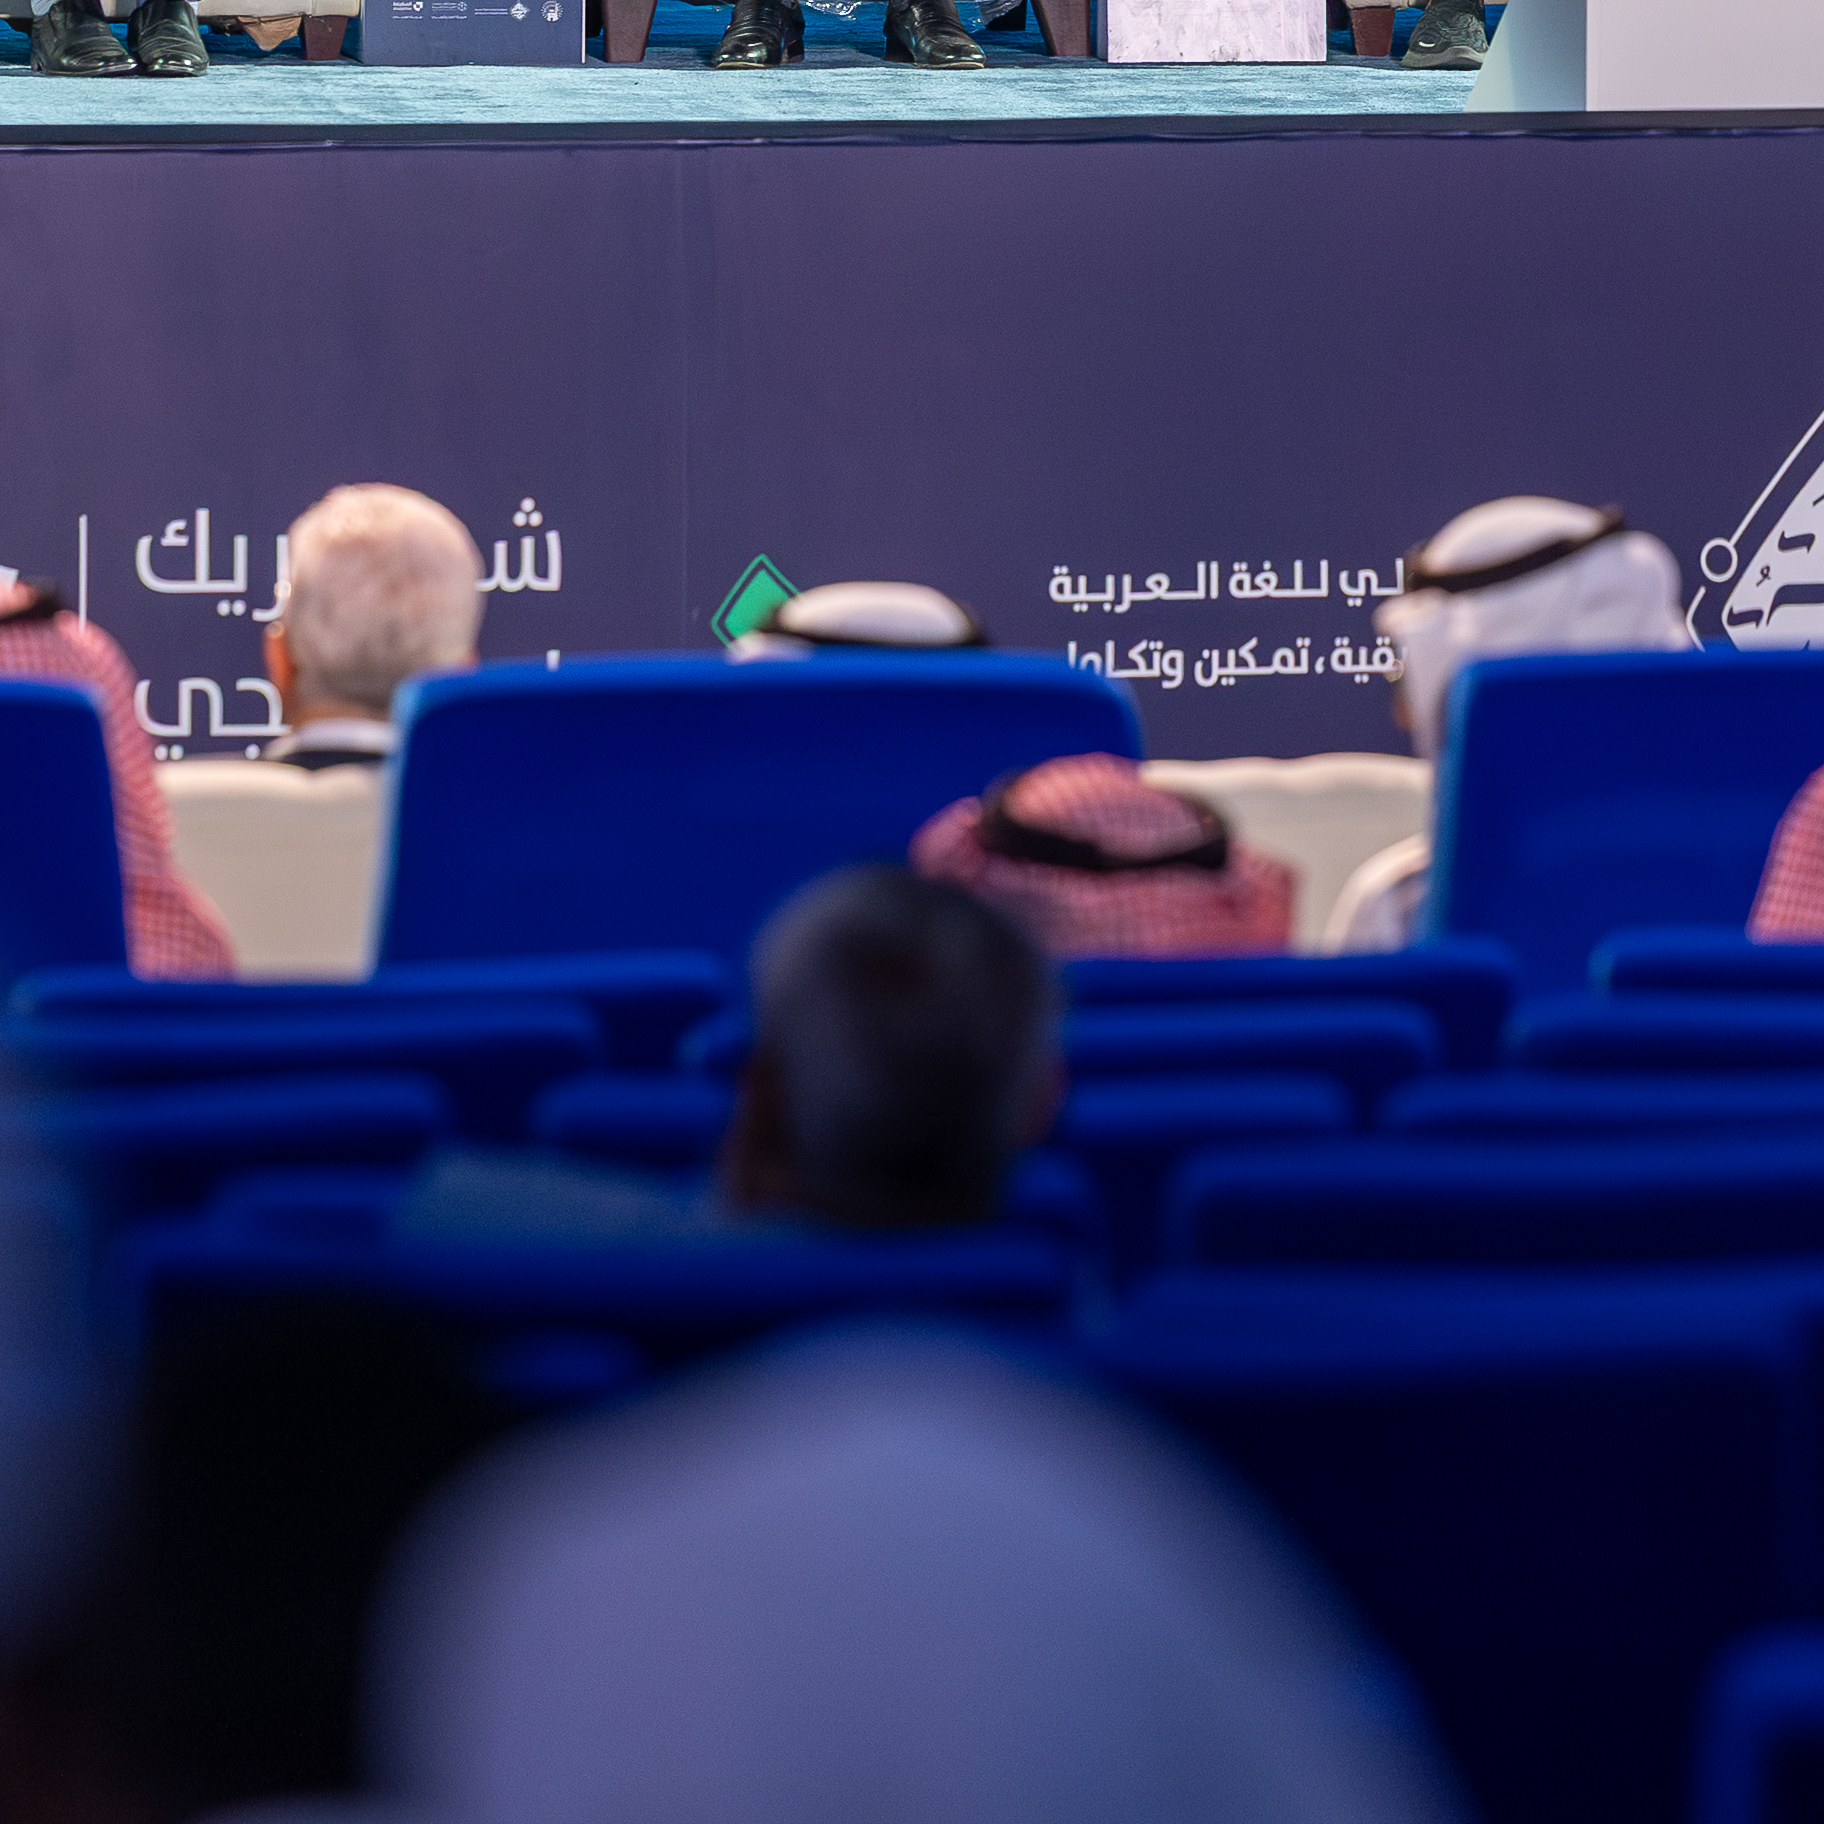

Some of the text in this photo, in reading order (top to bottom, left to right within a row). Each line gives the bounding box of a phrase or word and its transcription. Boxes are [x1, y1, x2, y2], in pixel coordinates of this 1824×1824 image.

[1048, 557, 1405, 613] لي للغة العربية
[1194, 636, 1311, 689] تمكين
